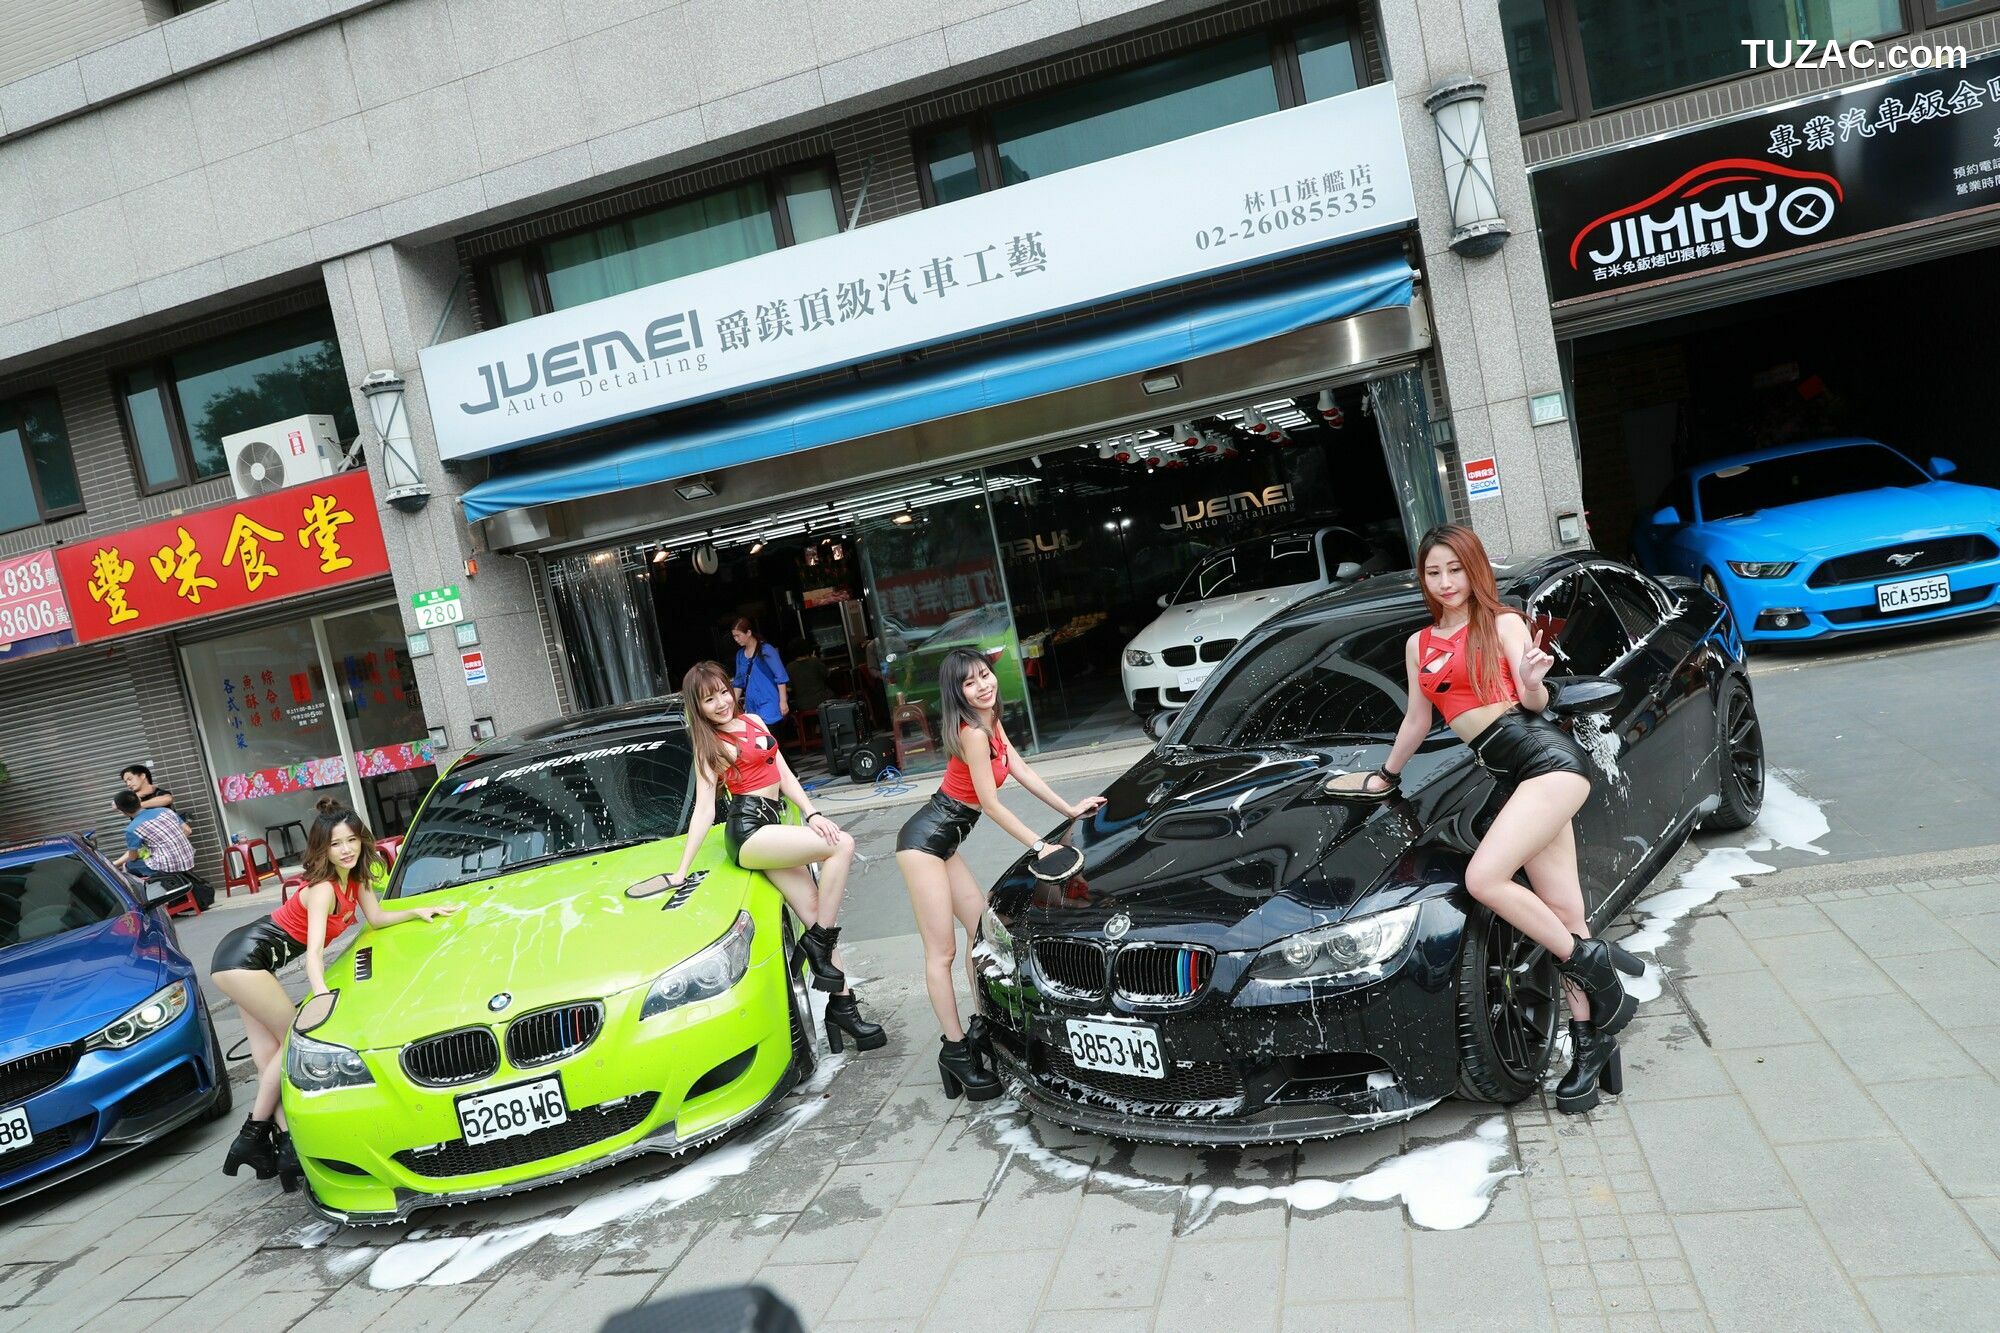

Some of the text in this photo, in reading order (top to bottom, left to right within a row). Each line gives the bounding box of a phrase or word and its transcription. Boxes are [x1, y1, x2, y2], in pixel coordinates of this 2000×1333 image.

[1243, 164, 1372, 214] 林口旗艦店
[1195, 187, 1376, 250] 02-26085535
[715, 231, 1047, 352] 爵鎂頂級汽車工藝
[460, 309, 704, 415] JUEMEI
[507, 353, 708, 416] Auto Detailing
[1160, 482, 1296, 531] JUEMEI
[1470, 479, 1497, 490] SECOM
[1185, 502, 1296, 531] Auto Detailing
[88, 494, 354, 625] 豐味食堂
[0, 600, 54, 638] 3606
[423, 603, 457, 626] 280
[495, 740, 666, 782] PERFORMANCE
